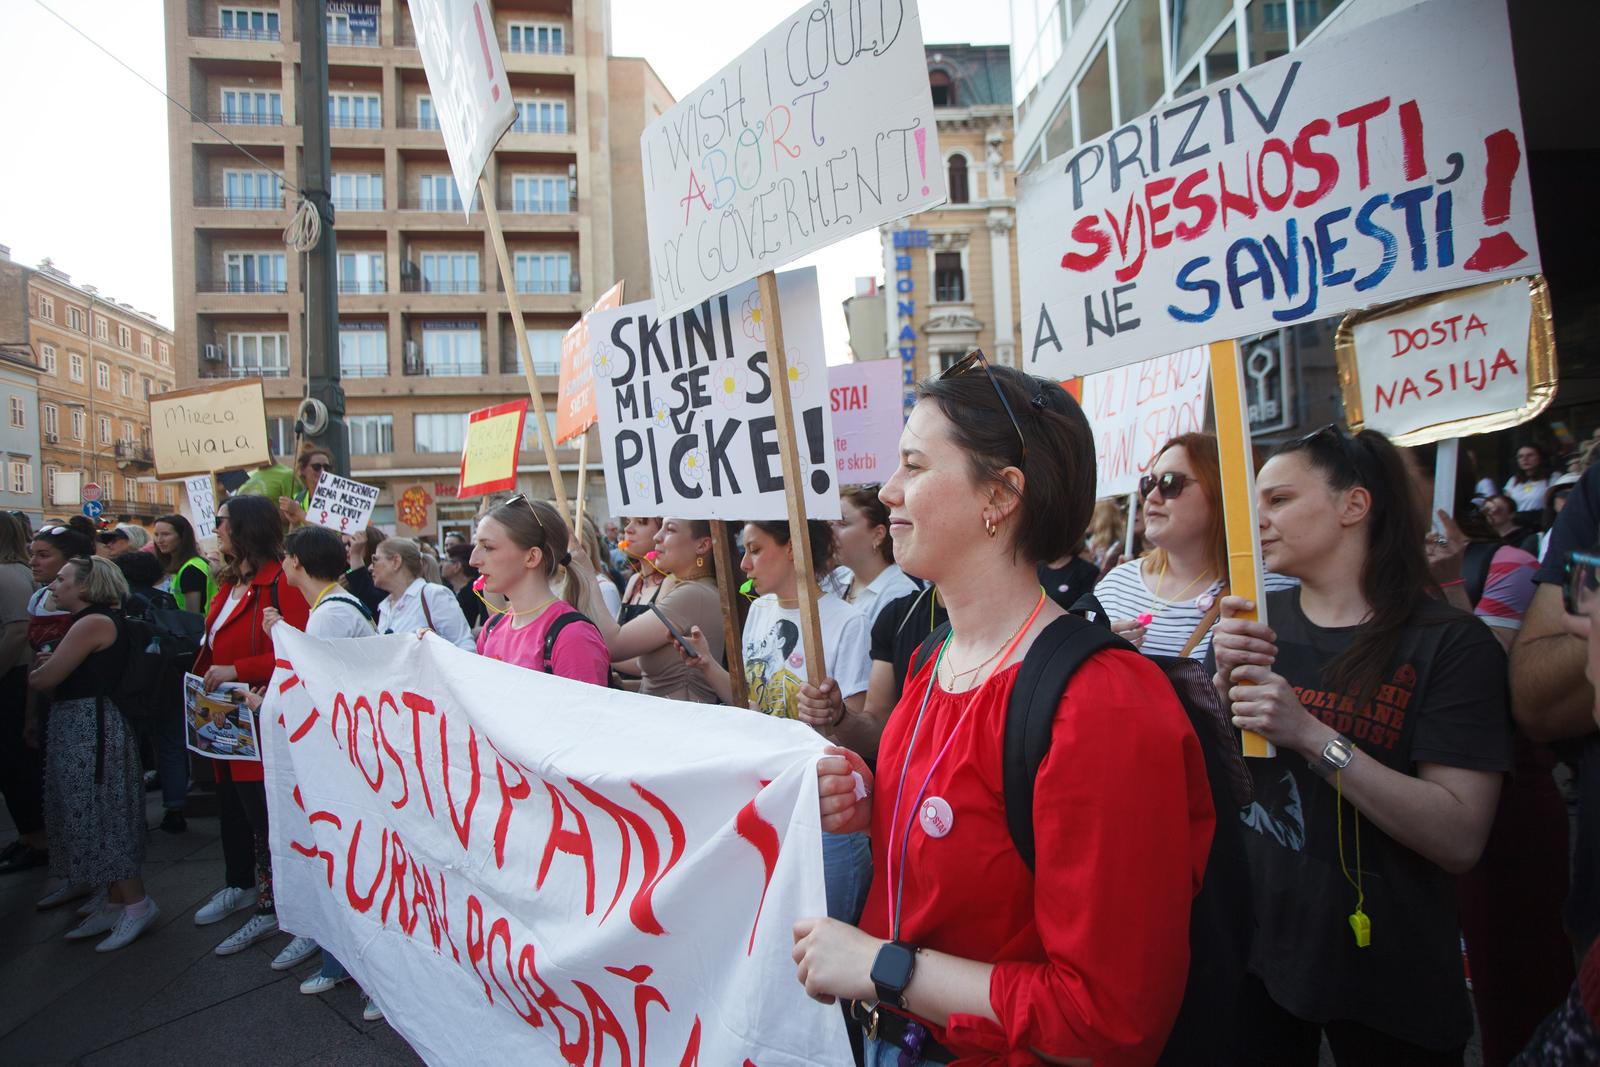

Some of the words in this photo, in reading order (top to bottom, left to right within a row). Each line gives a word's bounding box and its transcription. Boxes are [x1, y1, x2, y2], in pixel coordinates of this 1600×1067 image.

[662, 64, 750, 172] WISH
[763, 47, 772, 106] I
[786, 0, 904, 87] COULD
[680, 80, 830, 227] ABORT
[1065, 61, 1302, 211] PRIZIV
[654, 232, 687, 312] MY
[696, 117, 931, 282] GOVERMENT!
[610, 294, 735, 388] SKINI
[1030, 302, 1063, 363] A
[1085, 282, 1142, 347] NE
[1388, 312, 1488, 358] DOSTA
[615, 380, 655, 424] MI
[669, 365, 713, 416] SE
[745, 351, 772, 405] S
[1375, 348, 1519, 413] NASILJA
[316, 486, 338, 501] NEMA
[340, 493, 372, 511] MJESTA
[319, 472, 328, 485] U
[332, 477, 379, 499] MATERNICI
[847, 453, 877, 471] skrbi
[312, 498, 327, 511] ZA
[330, 502, 363, 523] CRKVU!
